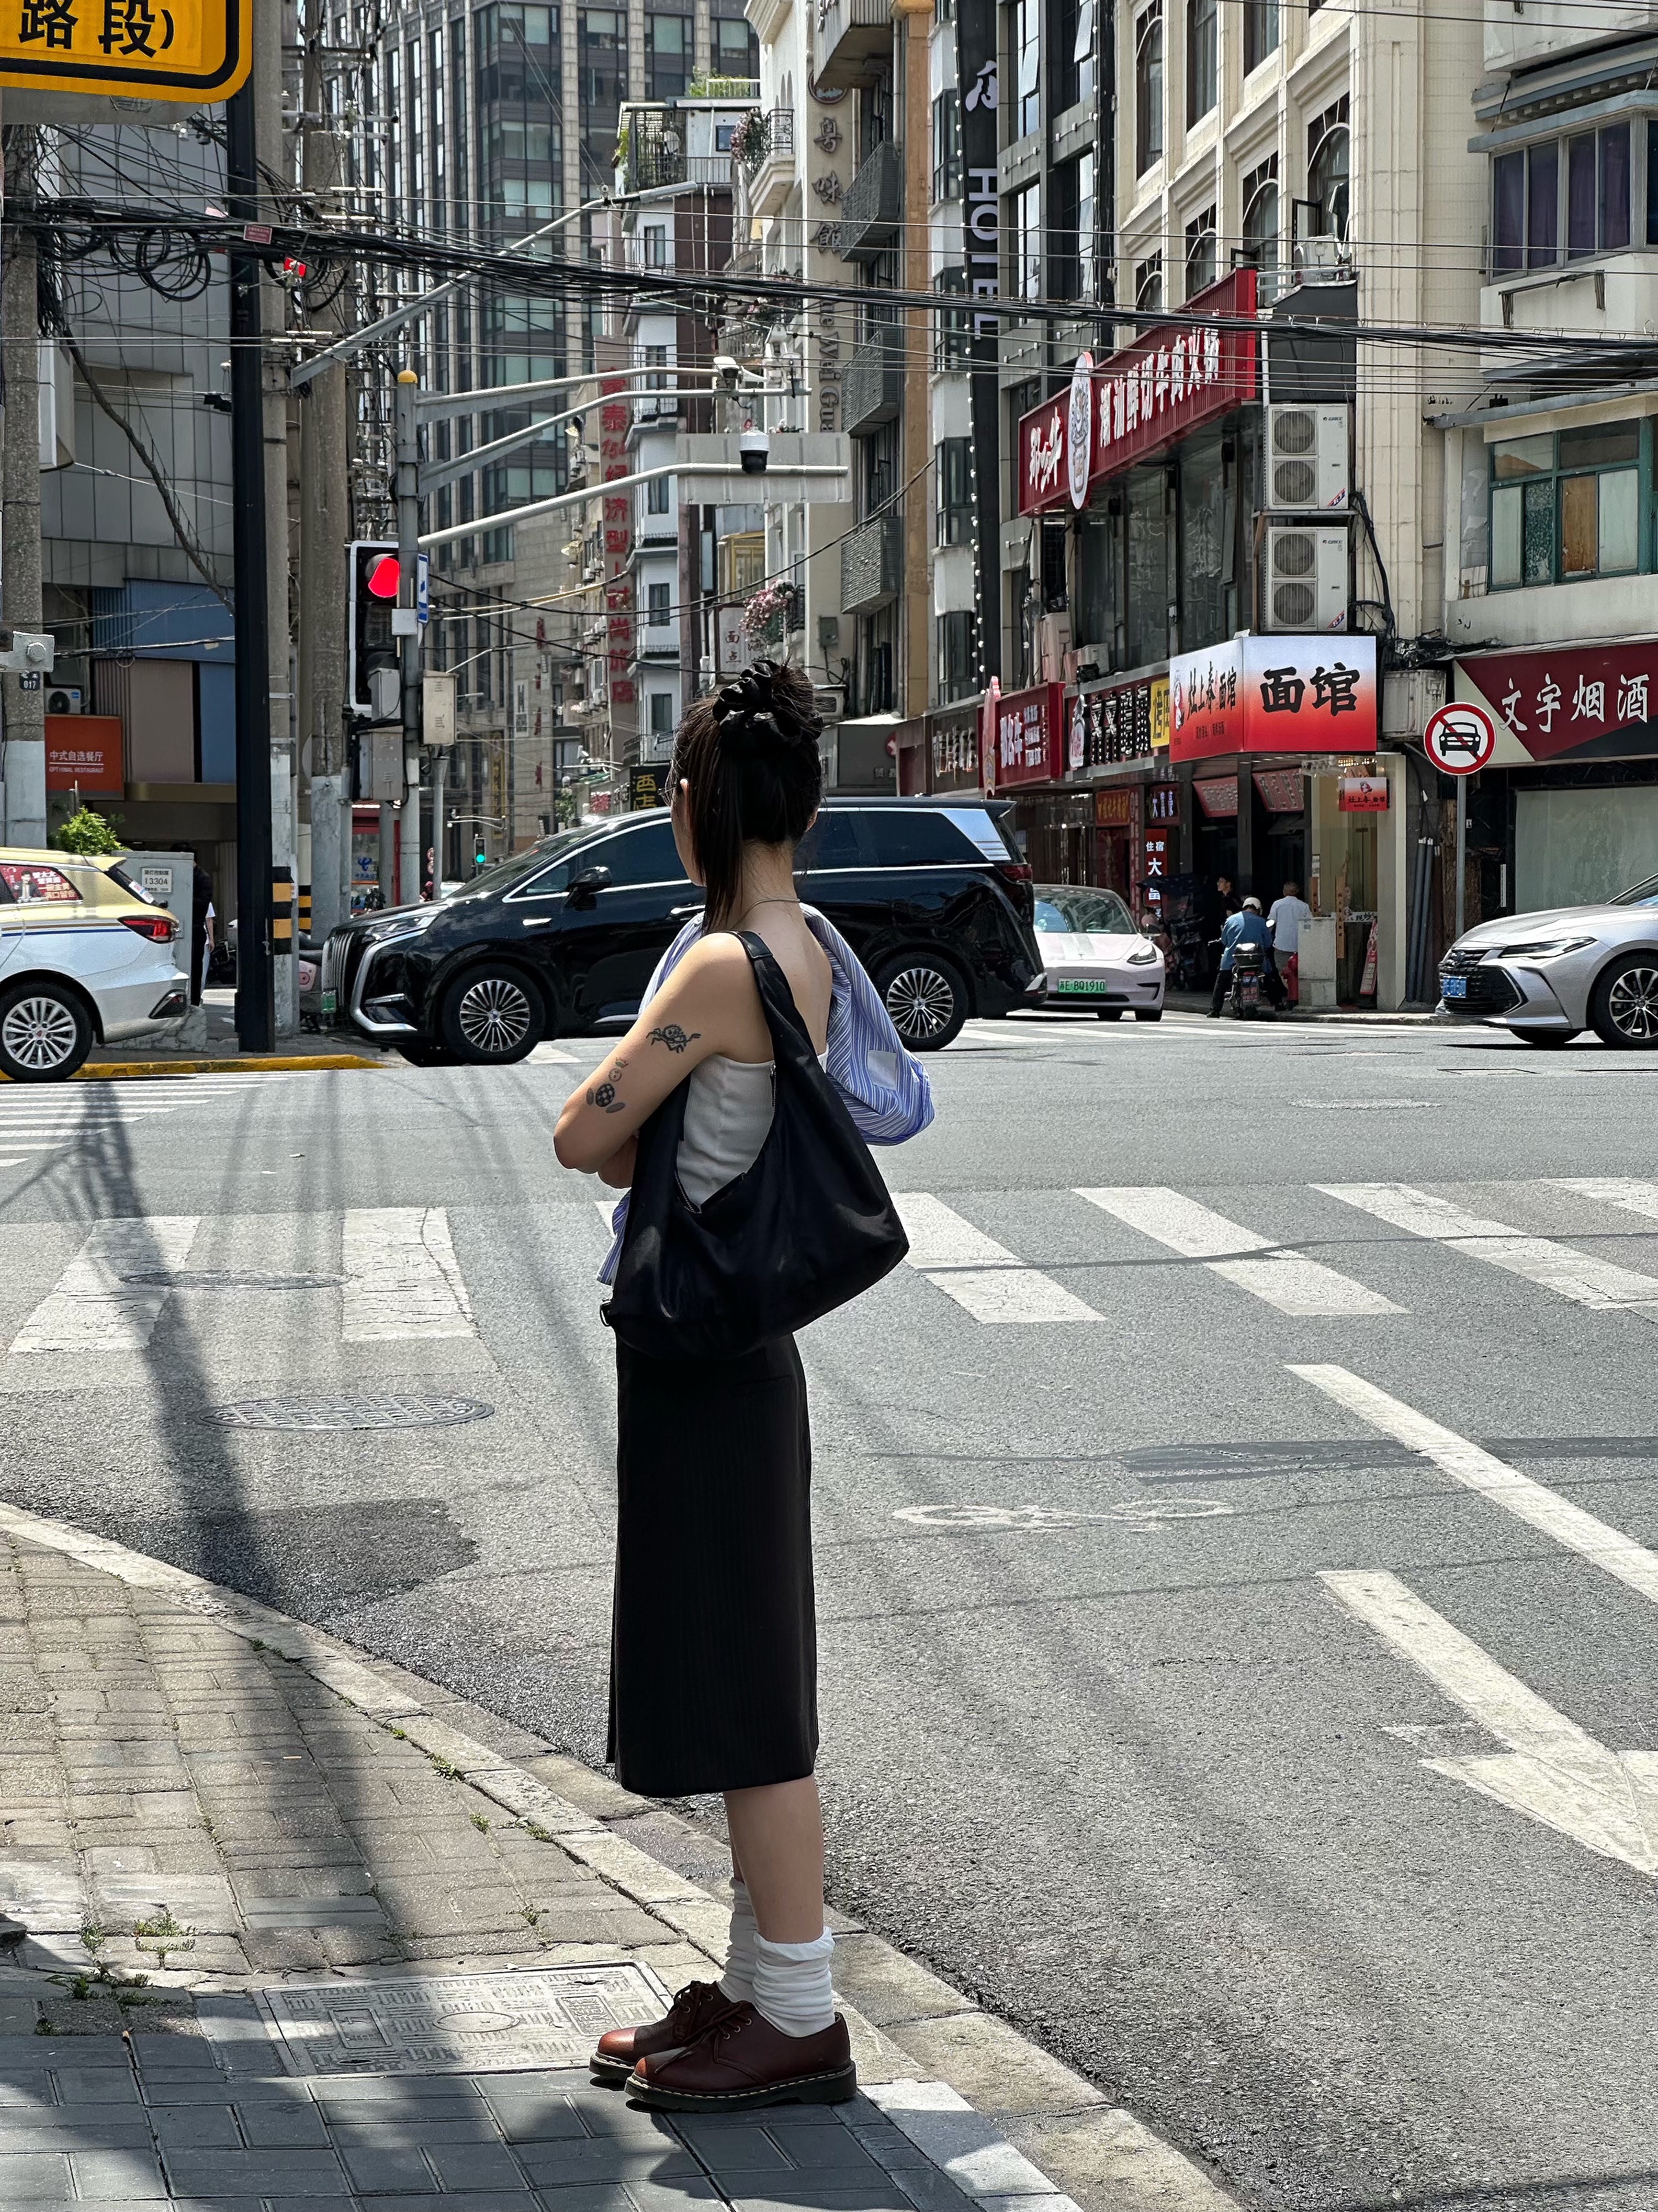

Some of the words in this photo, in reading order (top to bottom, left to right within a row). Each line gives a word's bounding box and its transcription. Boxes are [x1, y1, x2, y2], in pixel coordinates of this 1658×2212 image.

[1260, 662, 1361, 716] 面馆
[1499, 673, 1649, 733] 文宇烟酒
[49, 750, 103, 762] 中式自选餐厅
[1146, 841, 1165, 852] 住宿
